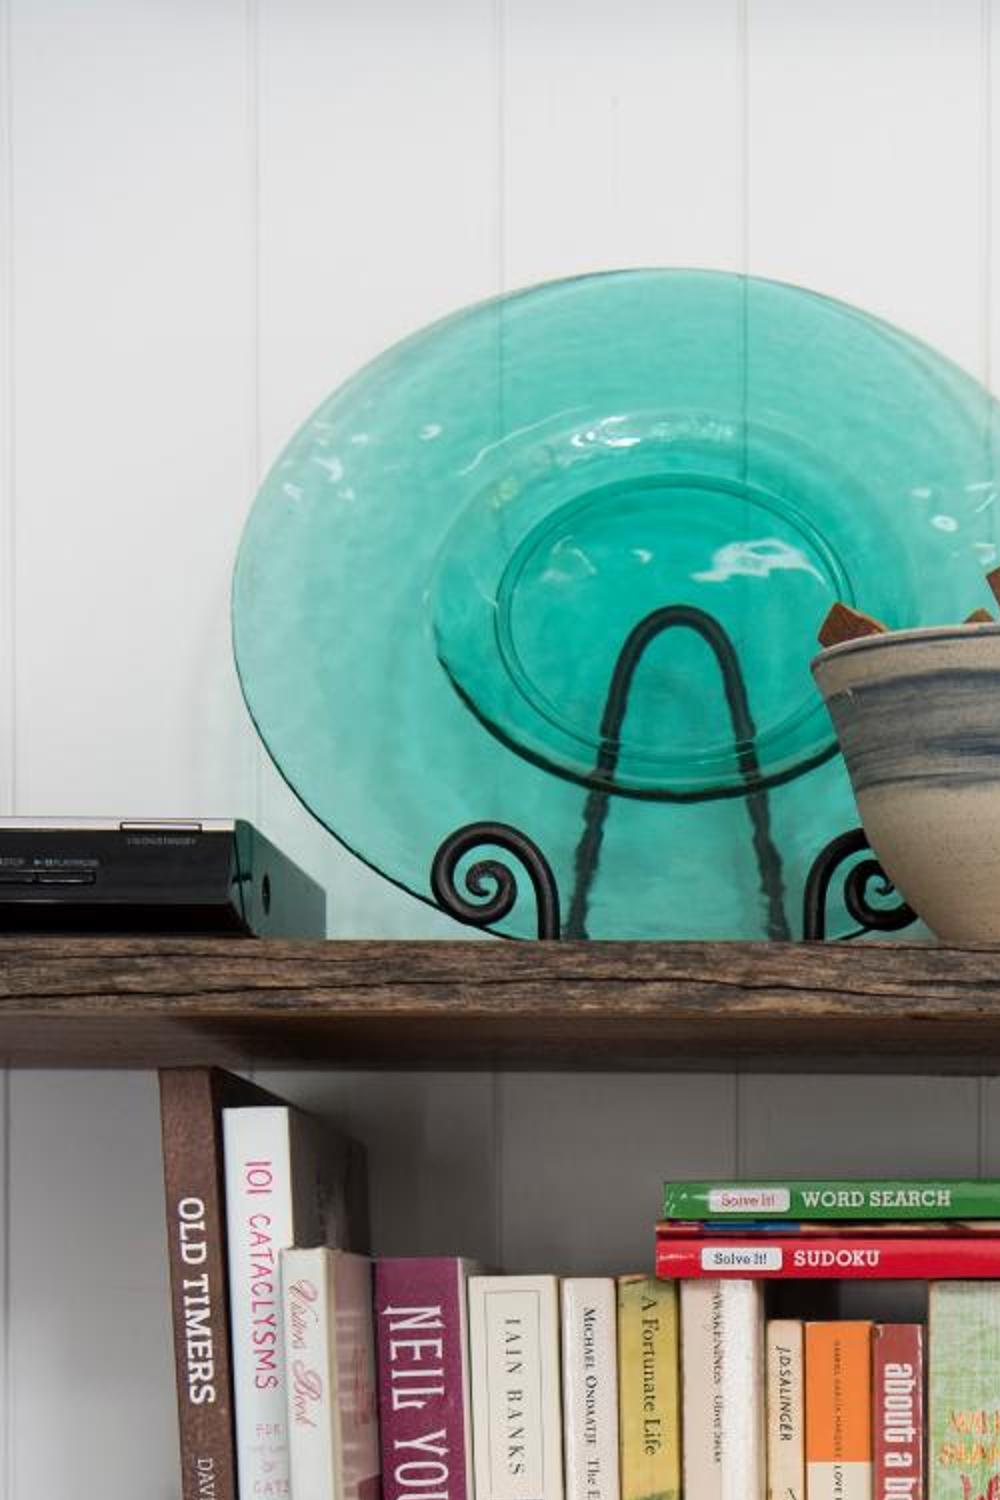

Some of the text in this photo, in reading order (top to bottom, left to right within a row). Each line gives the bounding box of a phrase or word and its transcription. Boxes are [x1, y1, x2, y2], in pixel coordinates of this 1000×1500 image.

[802, 1189, 952, 1208] WORD SEARCH
[176, 1196, 214, 1405] OLD TIMERS
[794, 1249, 881, 1268] SUDOKU
[382, 1303, 444, 1409] NEIL
[504, 1318, 525, 1477] IAIN BANKS
[583, 1307, 600, 1447] MICHAEL ONDAATJE
[641, 1295, 662, 1456] A Fortunate Life
[884, 1363, 916, 1443] about
[587, 1458, 601, 1484] The
[884, 1451, 911, 1466] a
